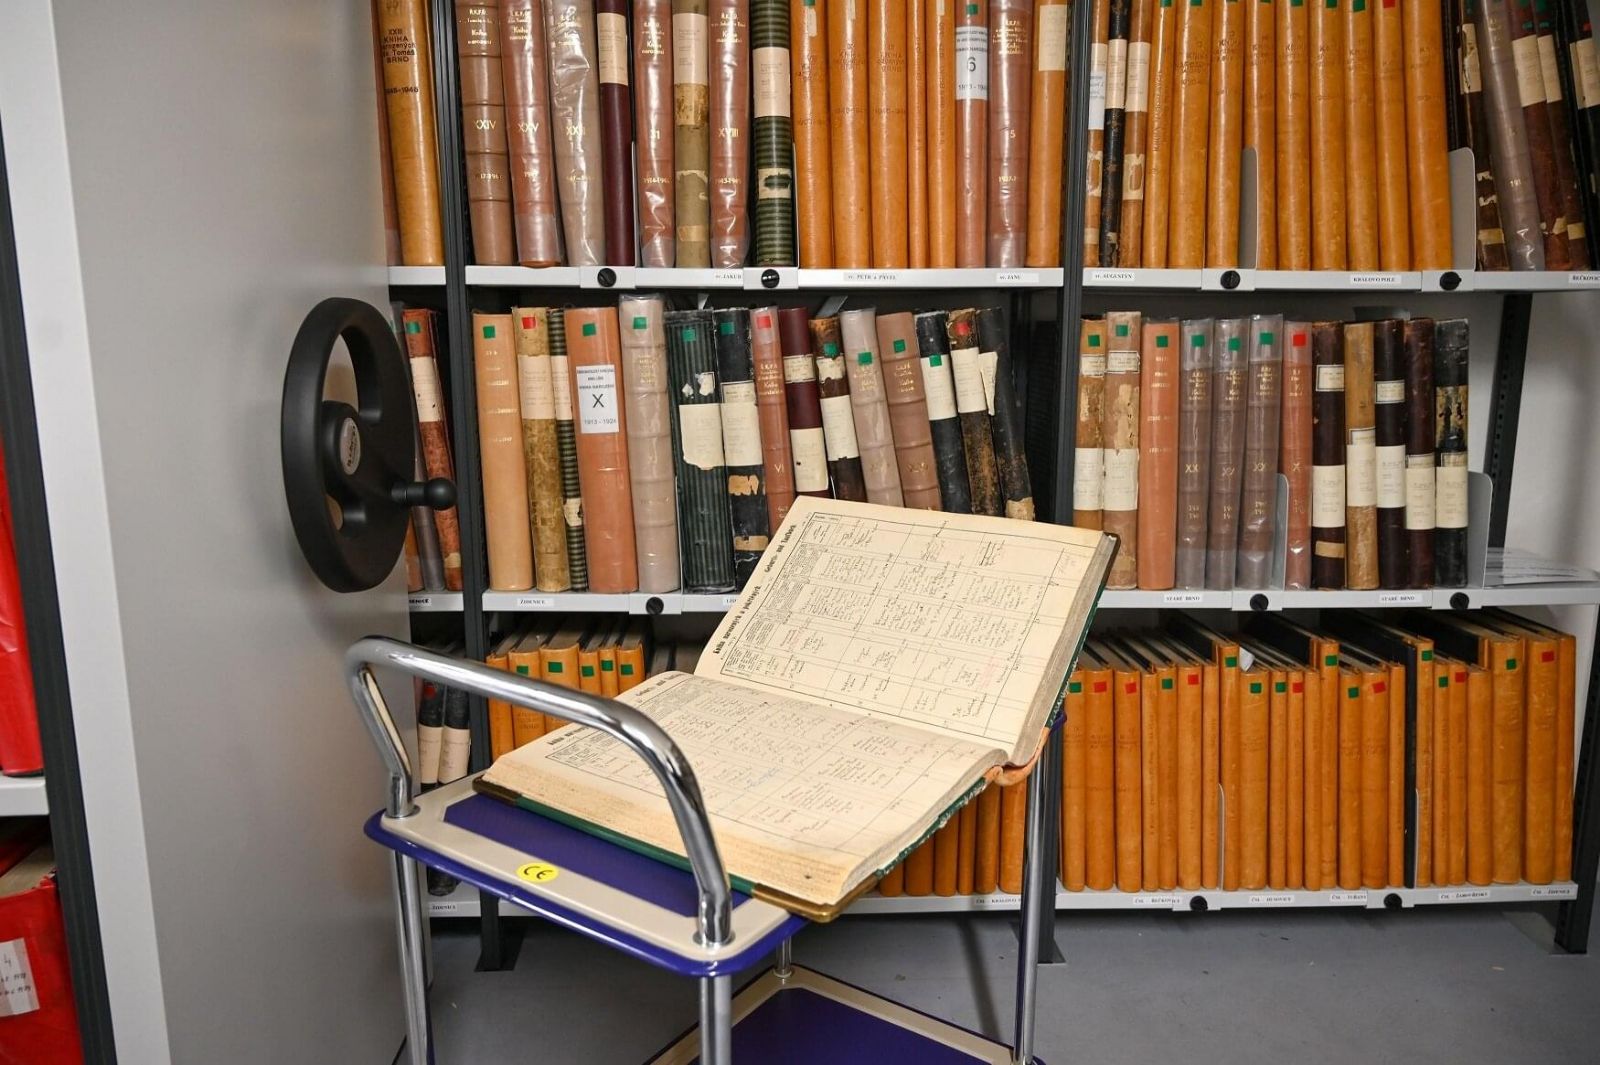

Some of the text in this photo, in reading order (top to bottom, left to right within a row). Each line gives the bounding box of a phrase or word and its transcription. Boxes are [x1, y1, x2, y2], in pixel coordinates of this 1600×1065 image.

[384, 35, 408, 43] KNIHA
[386, 56, 410, 64] BRNO
[967, 56, 976, 72] 6
[592, 393, 605, 409] X
